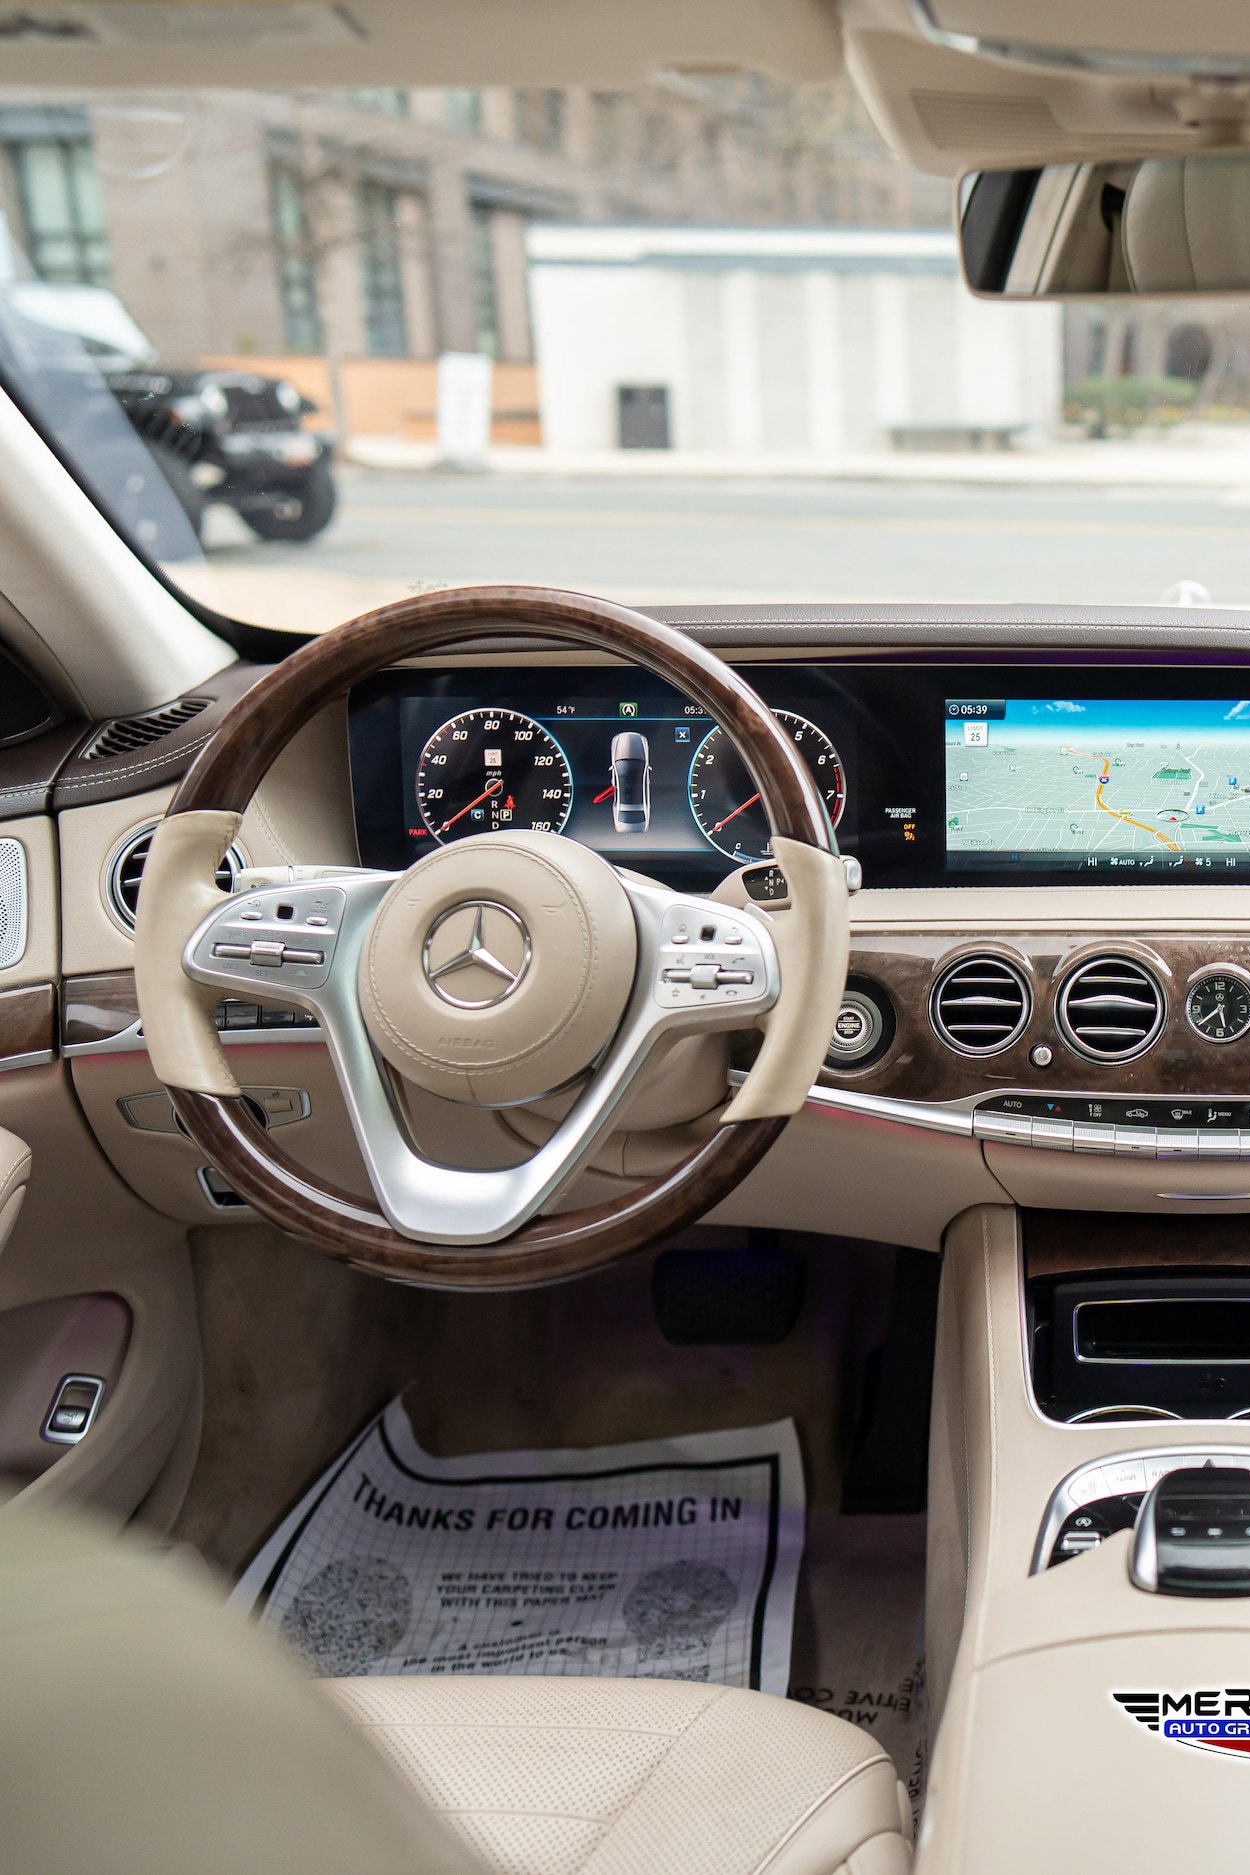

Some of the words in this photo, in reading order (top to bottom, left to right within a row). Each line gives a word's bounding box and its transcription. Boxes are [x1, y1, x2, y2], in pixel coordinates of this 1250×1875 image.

[684, 705, 707, 715] 05:3
[961, 705, 988, 715] 05:39
[484, 720, 500, 730] 80
[452, 731, 468, 741] 60
[514, 731, 533, 741] 100
[794, 731, 803, 741] 5
[970, 733, 981, 742] 25
[431, 755, 447, 765] 40
[534, 756, 553, 766] 120
[705, 755, 714, 765] 2
[818, 755, 826, 765] 6
[486, 770, 502, 778] mph
[427, 789, 444, 799] 20
[542, 789, 562, 799] 140
[700, 790, 706, 799] 1
[826, 790, 835, 800] 7
[491, 800, 498, 808] R
[492, 811, 499, 819] N
[503, 811, 509, 819] P
[492, 822, 500, 830] D
[532, 822, 551, 831] 160
[734, 842, 742, 850] C
[1087, 858, 1098, 867] HI
[1118, 858, 1136, 866] AUTO
[1206, 858, 1212, 867] 5
[1226, 858, 1236, 867] HI
[768, 870, 774, 878] R
[769, 888, 774, 896] D
[1214, 982, 1226, 990] 12
[1192, 1004, 1200, 1014] 9
[1240, 1004, 1248, 1014] 3
[1216, 1028, 1224, 1037] 6
[437, 1036, 496, 1050] AIRBAG
[1003, 1100, 1022, 1108] AUTO
[353, 1472, 475, 1531] THANKS
[486, 1507, 555, 1531] FOR
[565, 1497, 697, 1530] COMING
[709, 1496, 742, 1522] IN
[436, 1584, 478, 1594] YOUR
[440, 1598, 480, 1608] WITH
[485, 1598, 518, 1608] THIS
[555, 1636, 608, 1648] person
